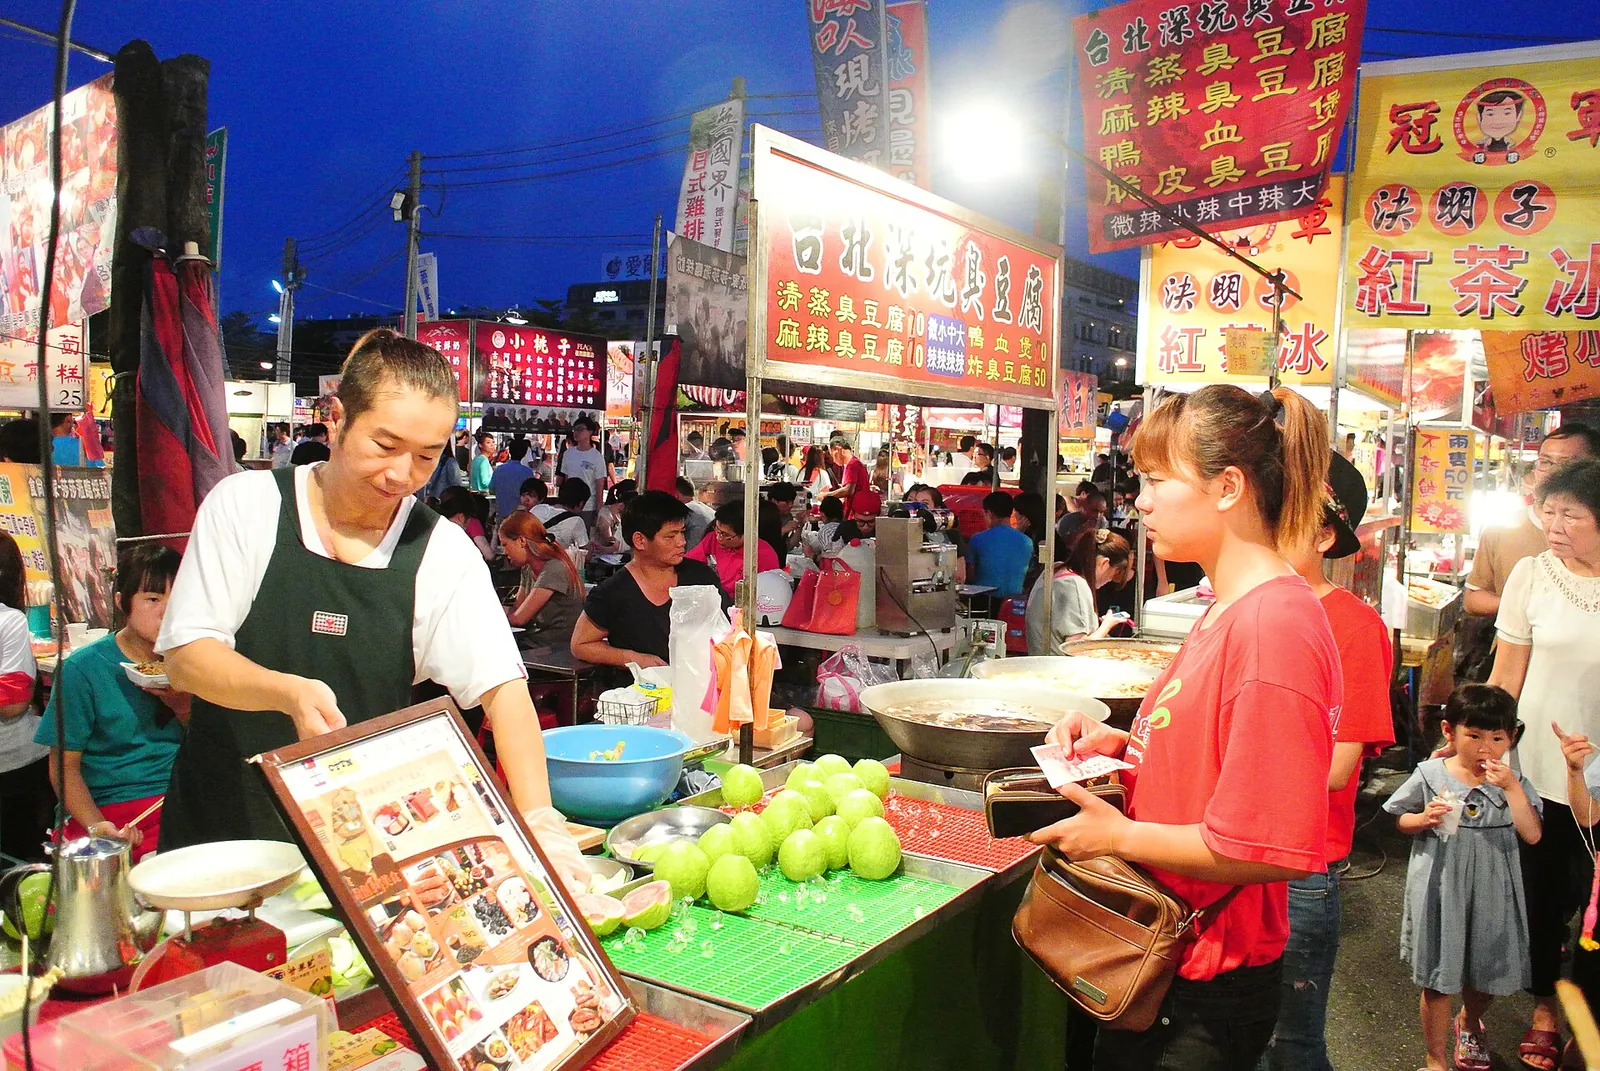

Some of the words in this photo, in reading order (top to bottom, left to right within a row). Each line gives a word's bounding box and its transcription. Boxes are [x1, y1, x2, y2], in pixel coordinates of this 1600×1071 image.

[1084, 0, 1350, 66] 台北深坑臭
[1094, 12, 1349, 98] 清蒸臭豆腐
[1098, 51, 1346, 136] 麻辣臭豆腐
[708, 106, 738, 202] 無國界
[1099, 89, 1341, 171] 鴨血煲
[683, 148, 708, 242] 日式雞排
[1110, 172, 1328, 239] 微辣小辣中辣大
[1371, 184, 1549, 232] 決明子
[788, 213, 1044, 334] 台北深坑臭豆腐
[1354, 243, 1600, 320] 紅茶冰
[775, 280, 906, 334] 清蒸臭豆腐
[509, 332, 571, 357] 小桃子
[775, 318, 905, 366] 麻辣臭豆腐
[966, 354, 1034, 387] 炸臭豆腐
[968, 325, 1034, 360] 鴨血煲
[60, 389, 82, 406] 25
